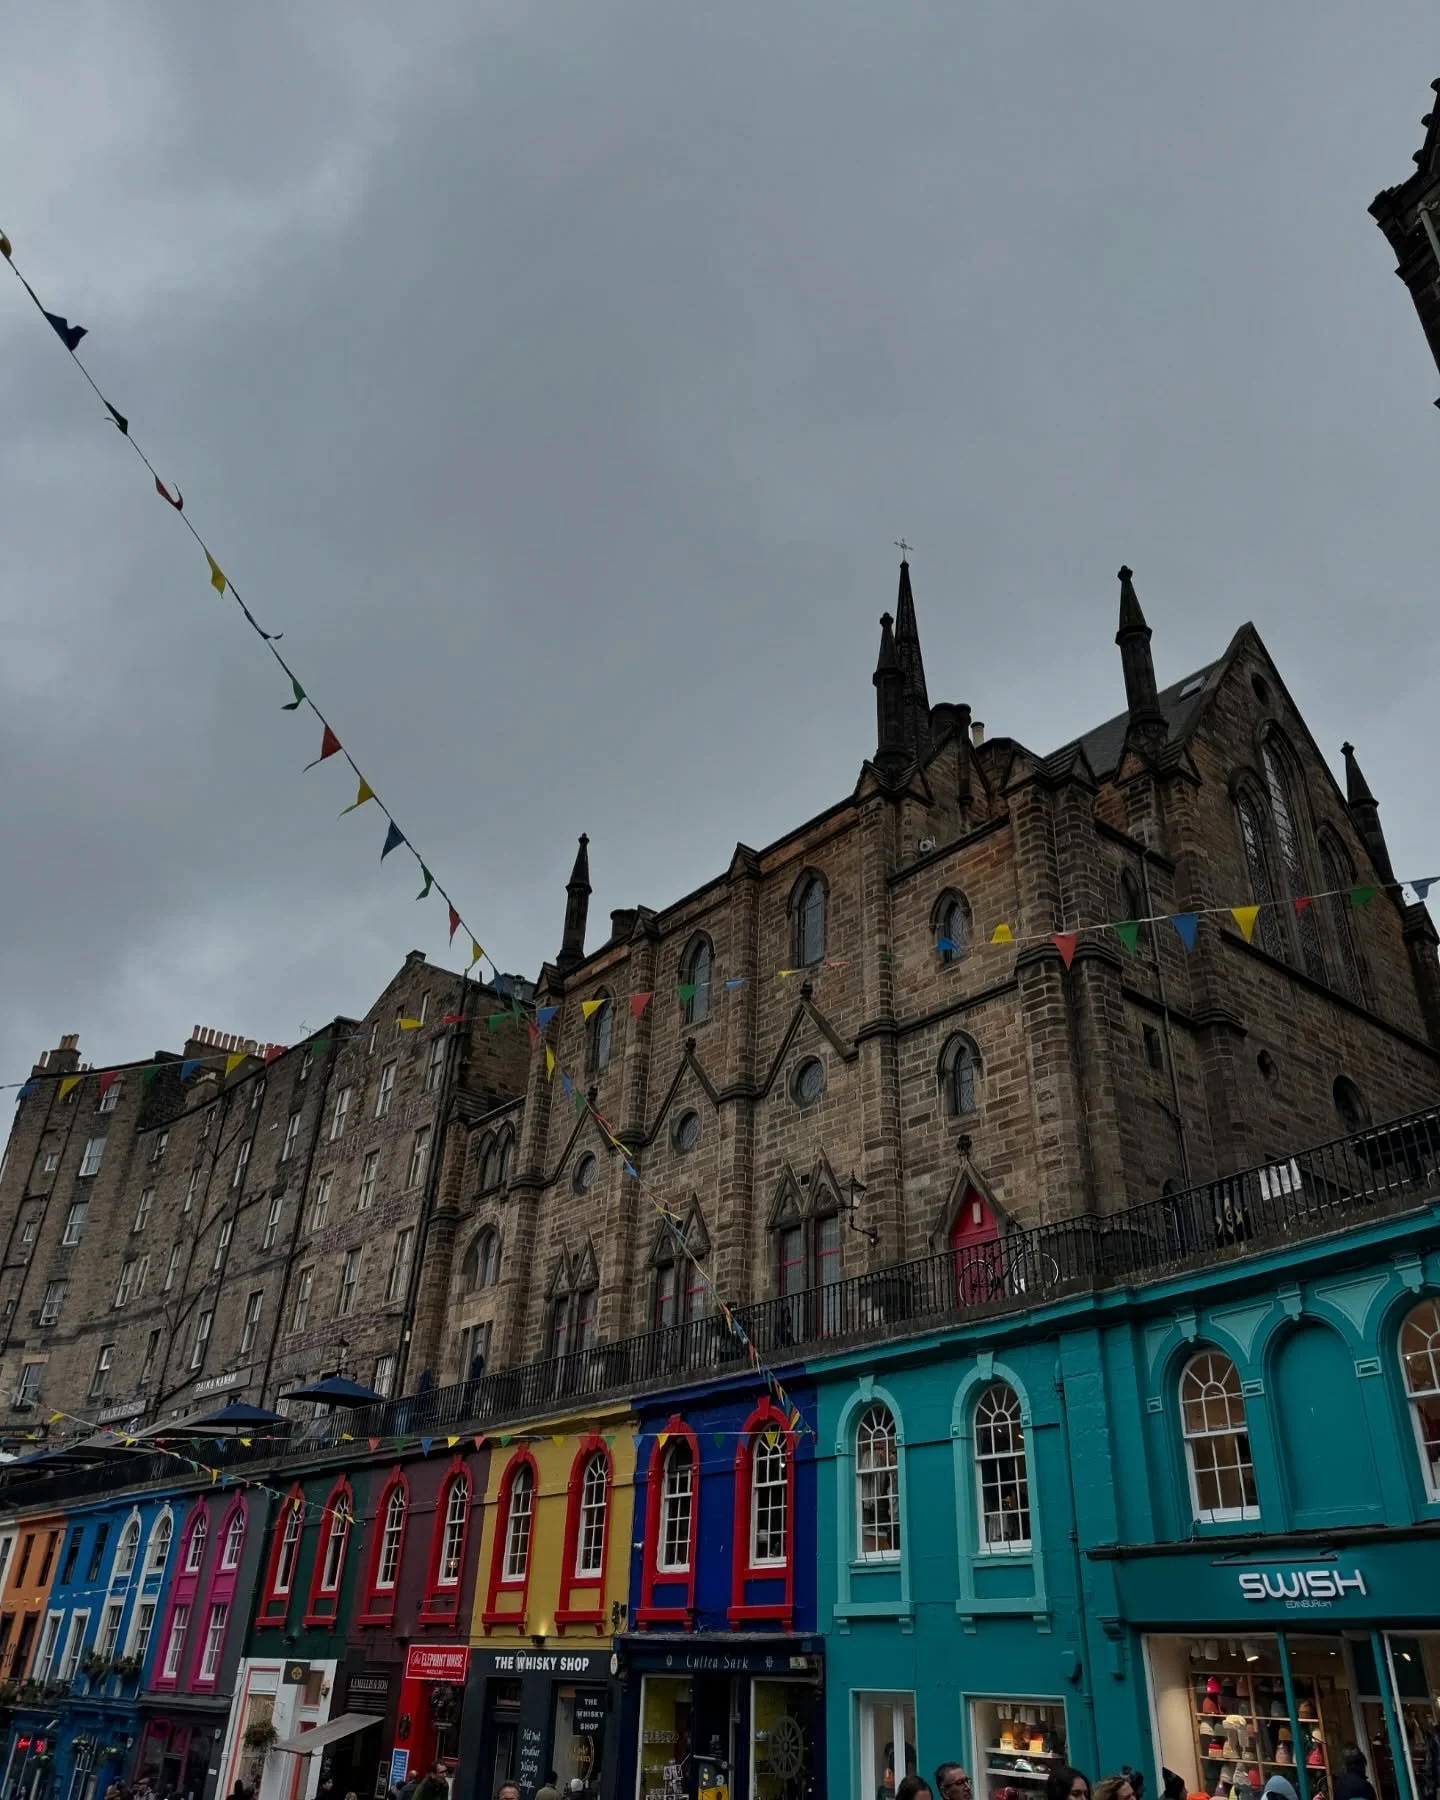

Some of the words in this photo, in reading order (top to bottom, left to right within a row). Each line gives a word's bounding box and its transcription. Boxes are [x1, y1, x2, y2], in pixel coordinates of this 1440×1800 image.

[1238, 1568, 1367, 1598] SWISH
[1284, 1599, 1332, 1608] EDINBURGH
[421, 1653, 446, 1667] ELEPHANT
[446, 1653, 464, 1668] HOUSE
[494, 1656, 514, 1670] THE
[516, 1656, 557, 1671] WHISKY
[560, 1657, 590, 1672] SHOP
[584, 1698, 598, 1706] THE
[576, 1710, 604, 1719] WHISKY
[580, 1723, 599, 1731] SHOP
